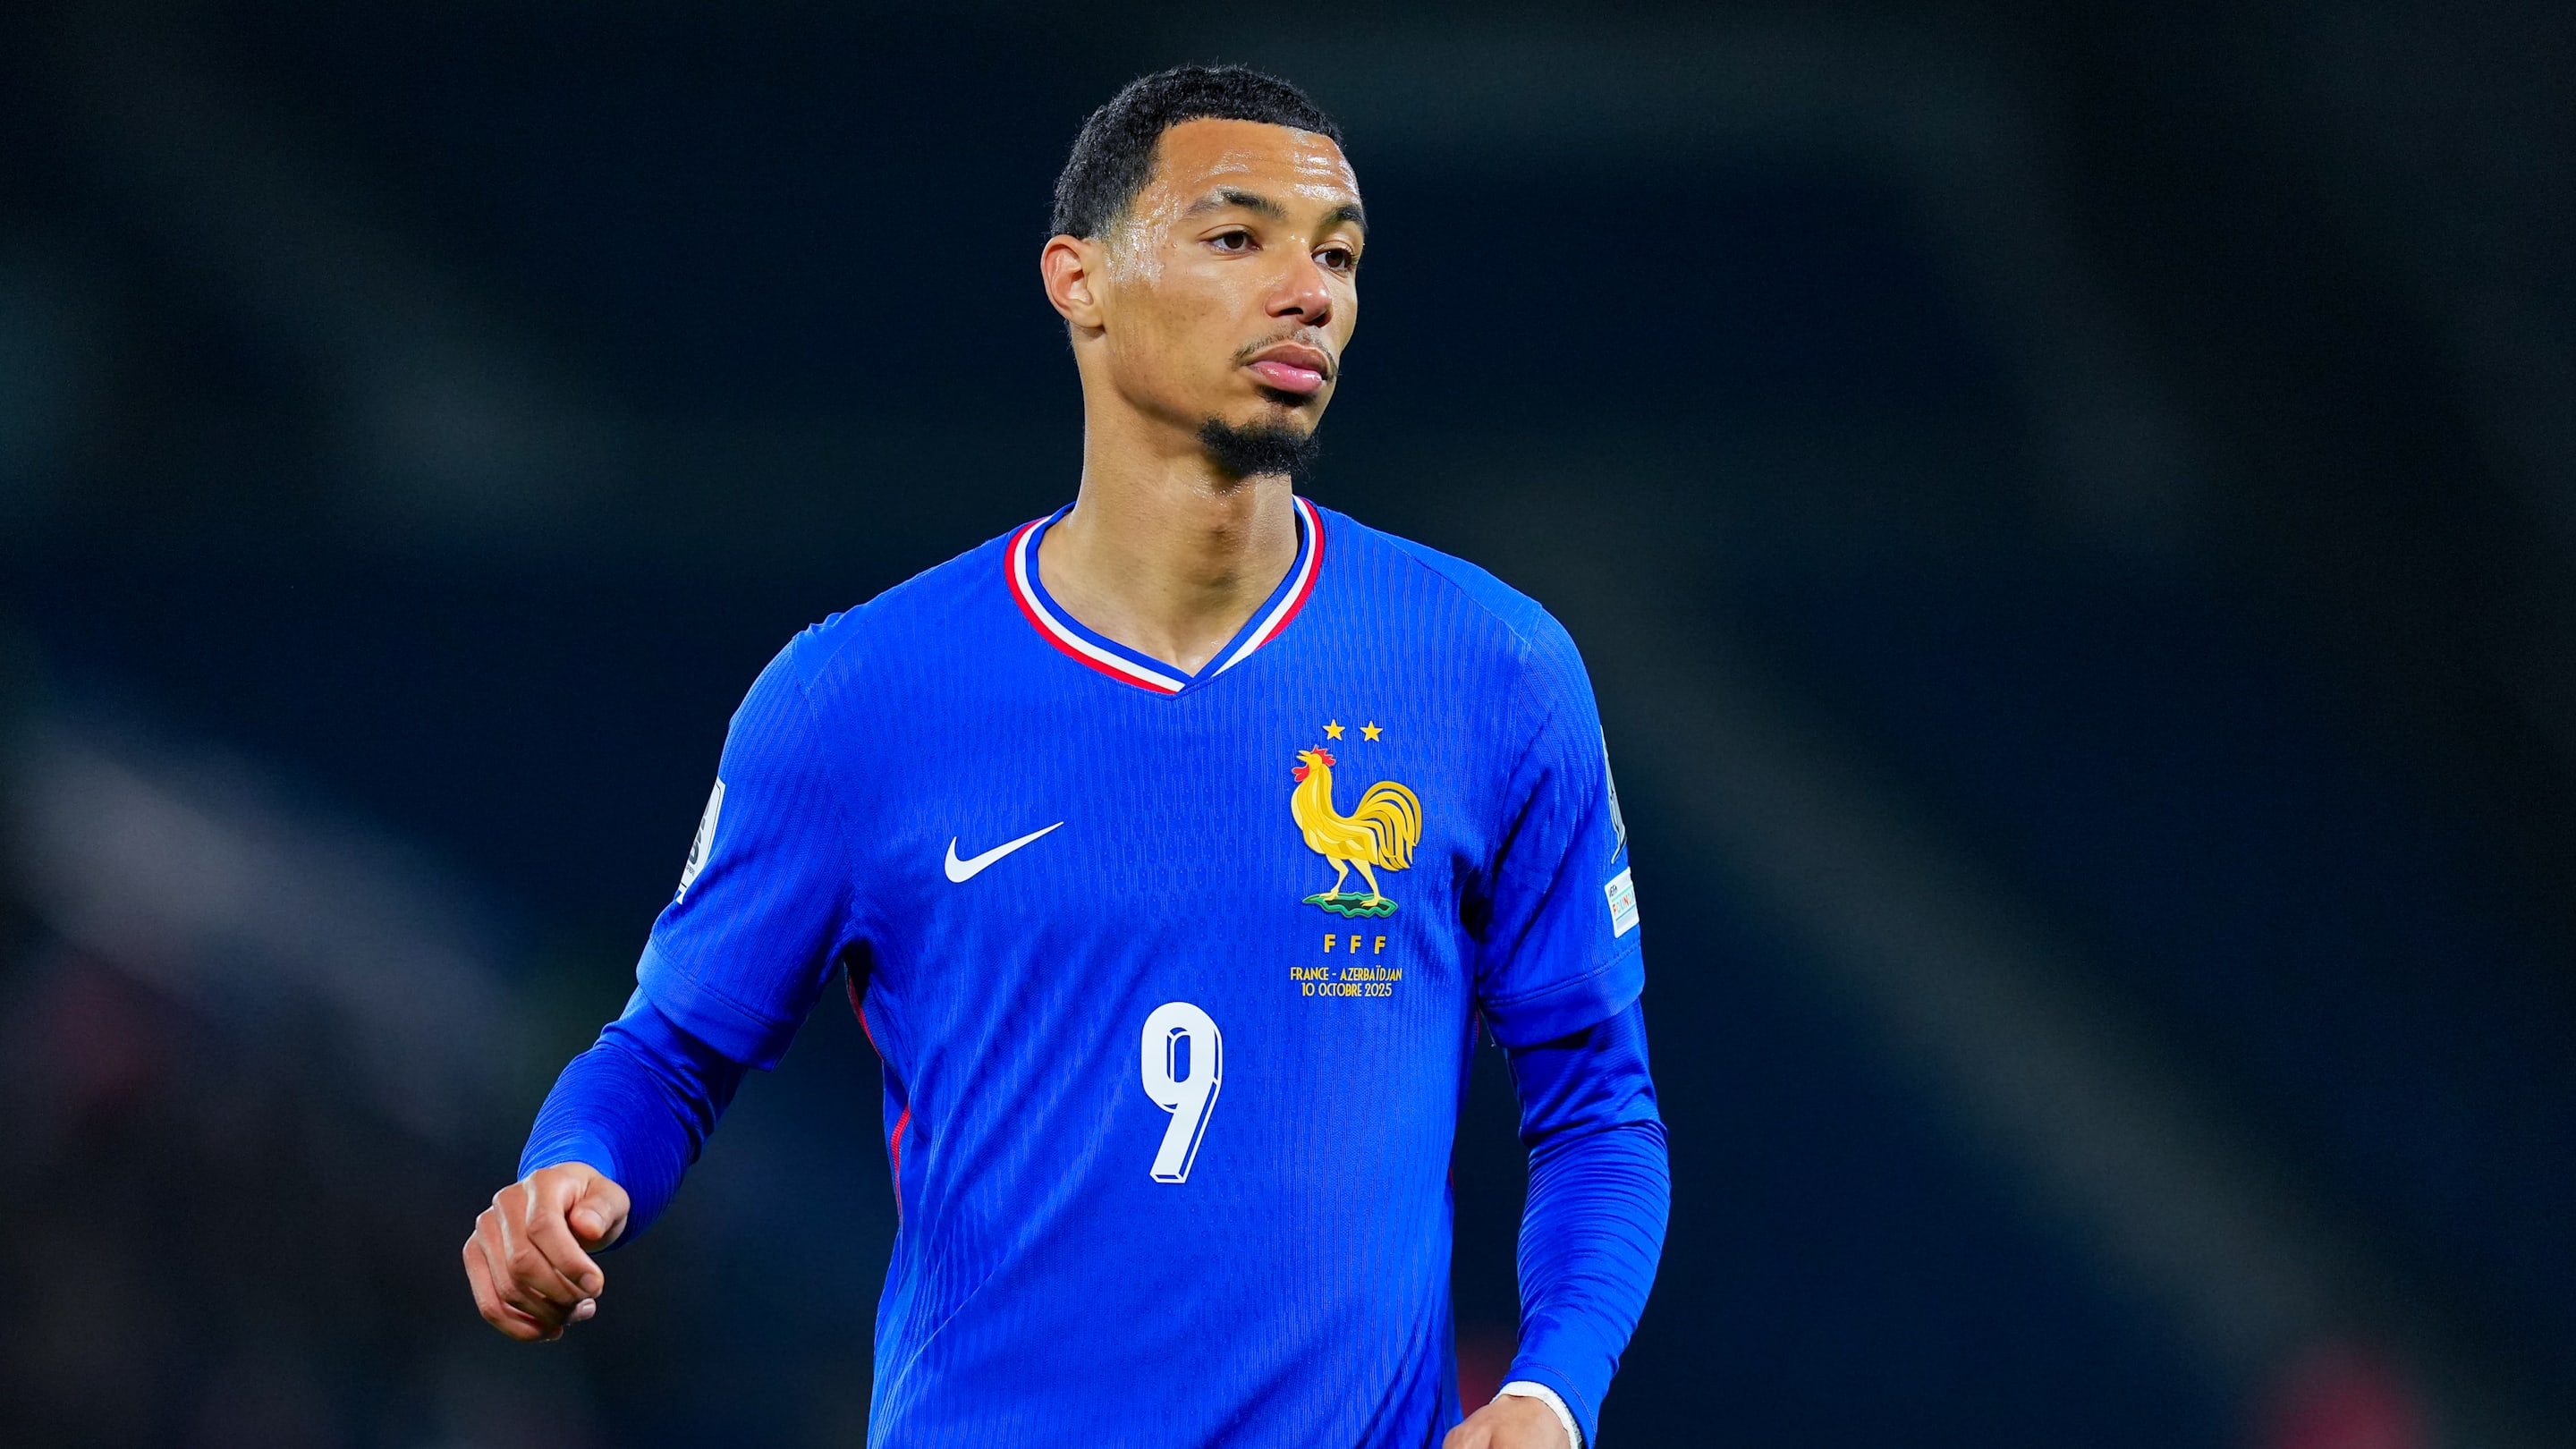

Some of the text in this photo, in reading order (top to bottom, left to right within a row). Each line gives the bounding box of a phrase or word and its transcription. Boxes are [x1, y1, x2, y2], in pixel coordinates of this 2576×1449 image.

[1290, 966, 1329, 981] FRANCE
[1340, 964, 1402, 981] AZERBAÏDJAN
[1301, 982, 1393, 997] 10 OCTOBRE 2025
[1140, 1001, 1223, 1183] 9
